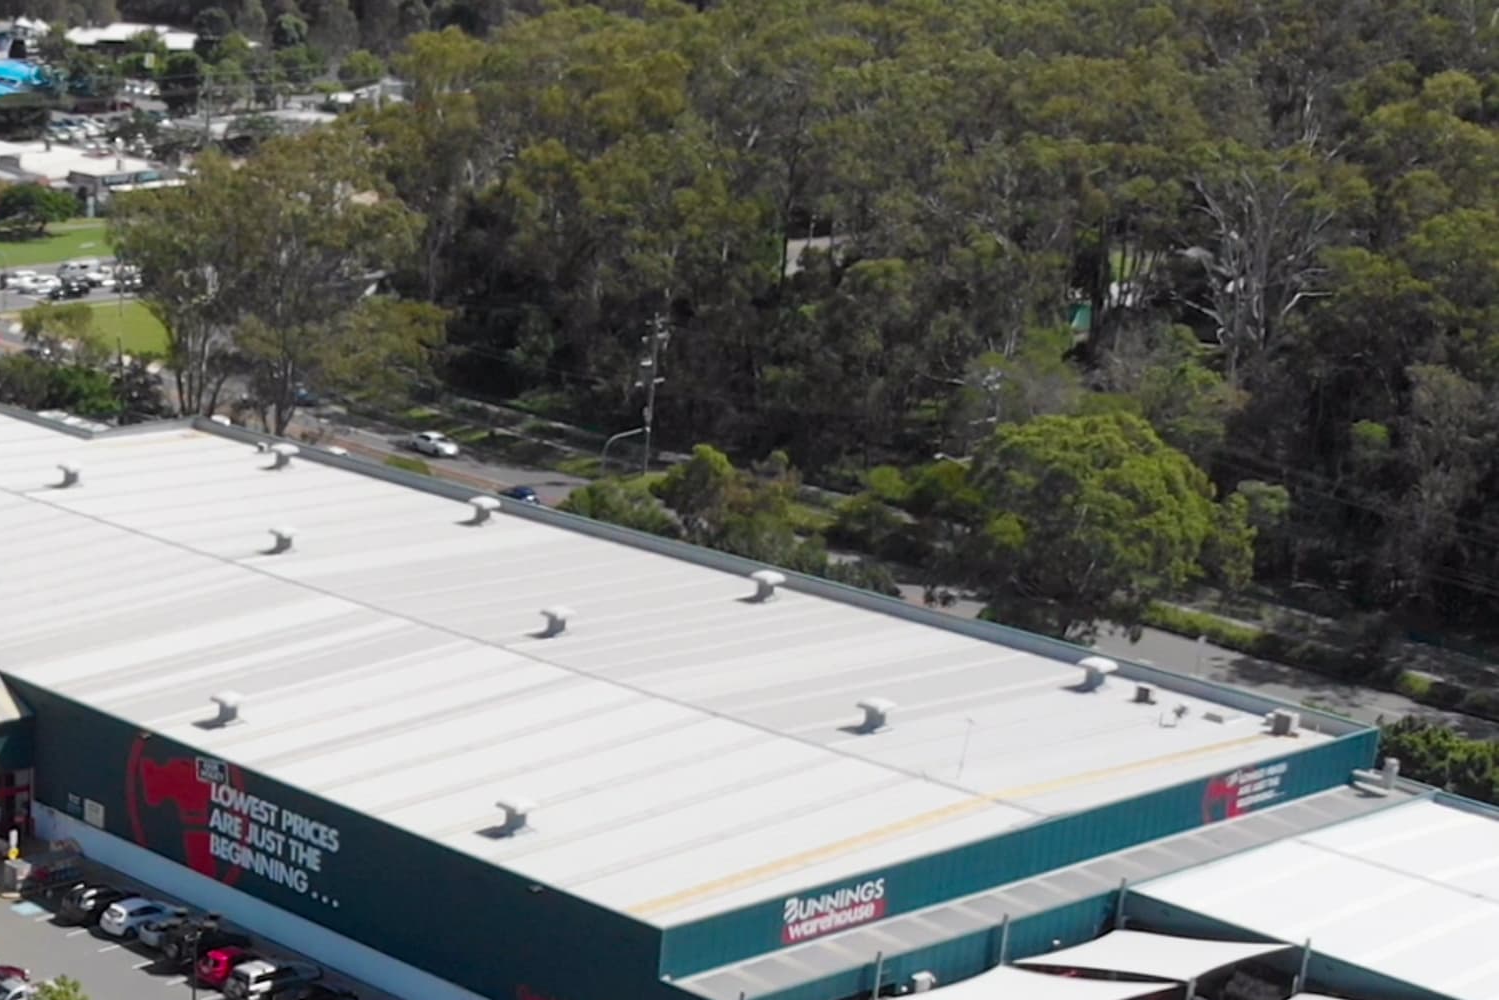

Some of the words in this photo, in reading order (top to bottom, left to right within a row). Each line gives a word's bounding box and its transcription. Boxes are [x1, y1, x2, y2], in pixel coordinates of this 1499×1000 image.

[209, 809, 242, 836] ARE
[245, 825, 286, 857] JUST
[288, 839, 322, 872] THE
[210, 782, 279, 825] LOWEST
[281, 810, 340, 853] PRICES
[783, 877, 886, 923] BUNNINGS
[787, 903, 876, 940] warehouse
